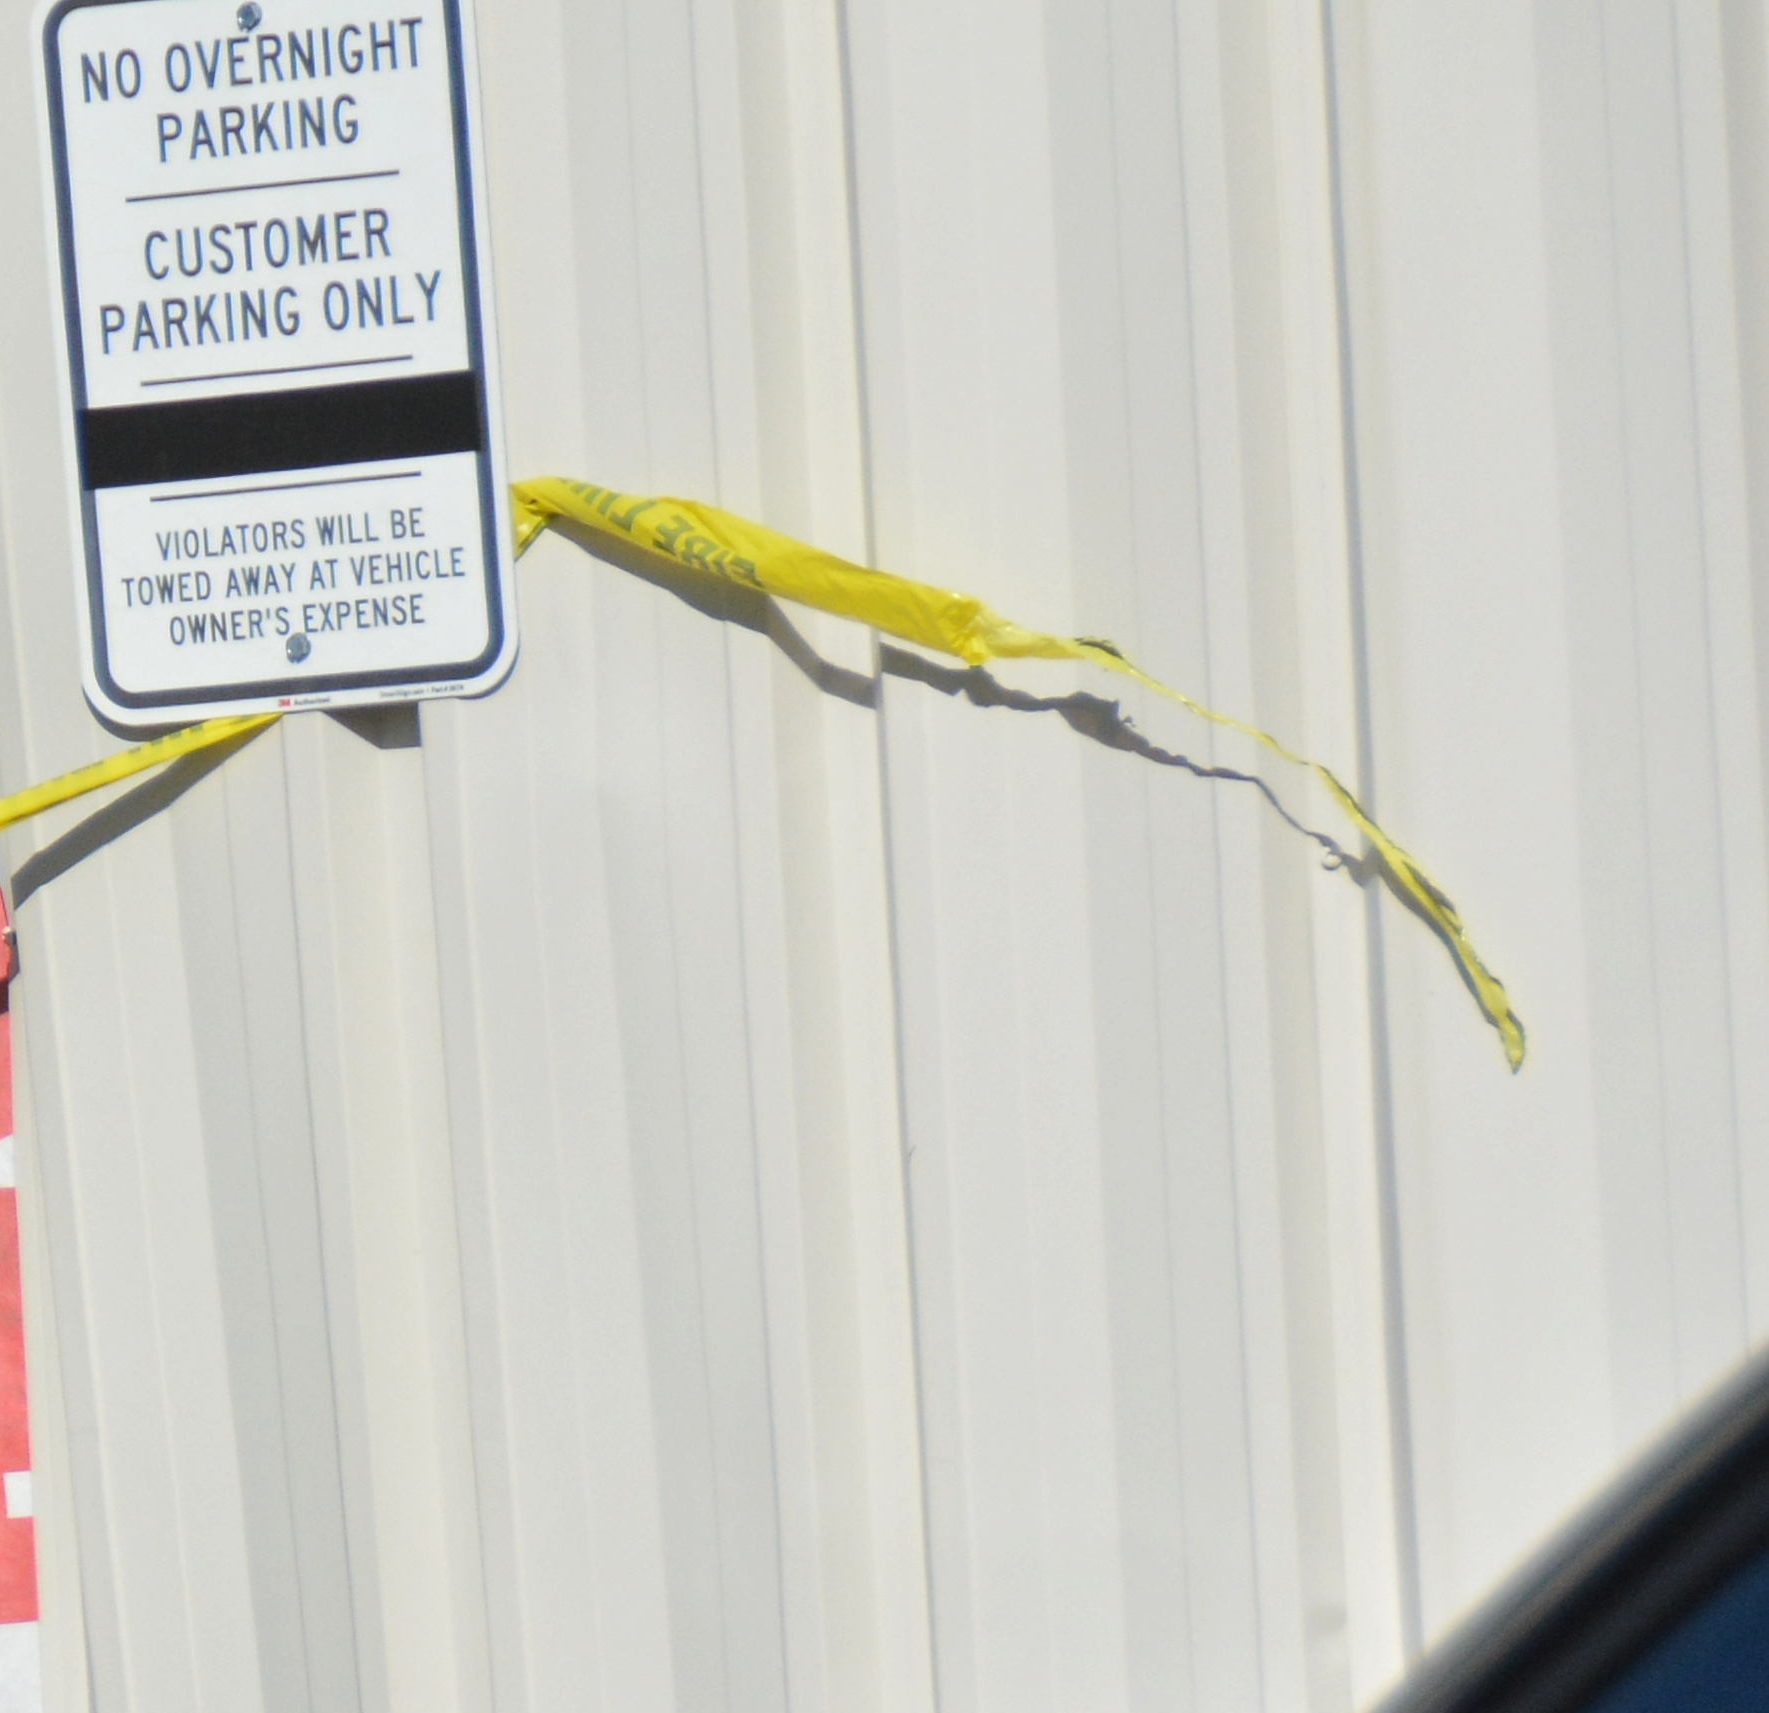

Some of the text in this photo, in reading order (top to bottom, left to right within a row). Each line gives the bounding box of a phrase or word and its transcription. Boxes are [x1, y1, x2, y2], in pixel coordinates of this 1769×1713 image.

[80, 16, 423, 103] NO OVERNIGHT
[156, 93, 360, 163] PARKING
[143, 207, 392, 281] CUSTOMER
[98, 269, 442, 355] PARKING ONLY
[155, 507, 426, 562] VIOLATORS WILL BE
[121, 546, 466, 608] TOWED AWAY AT VEHICLE
[169, 593, 426, 646] OWNER'S EXPENSE
